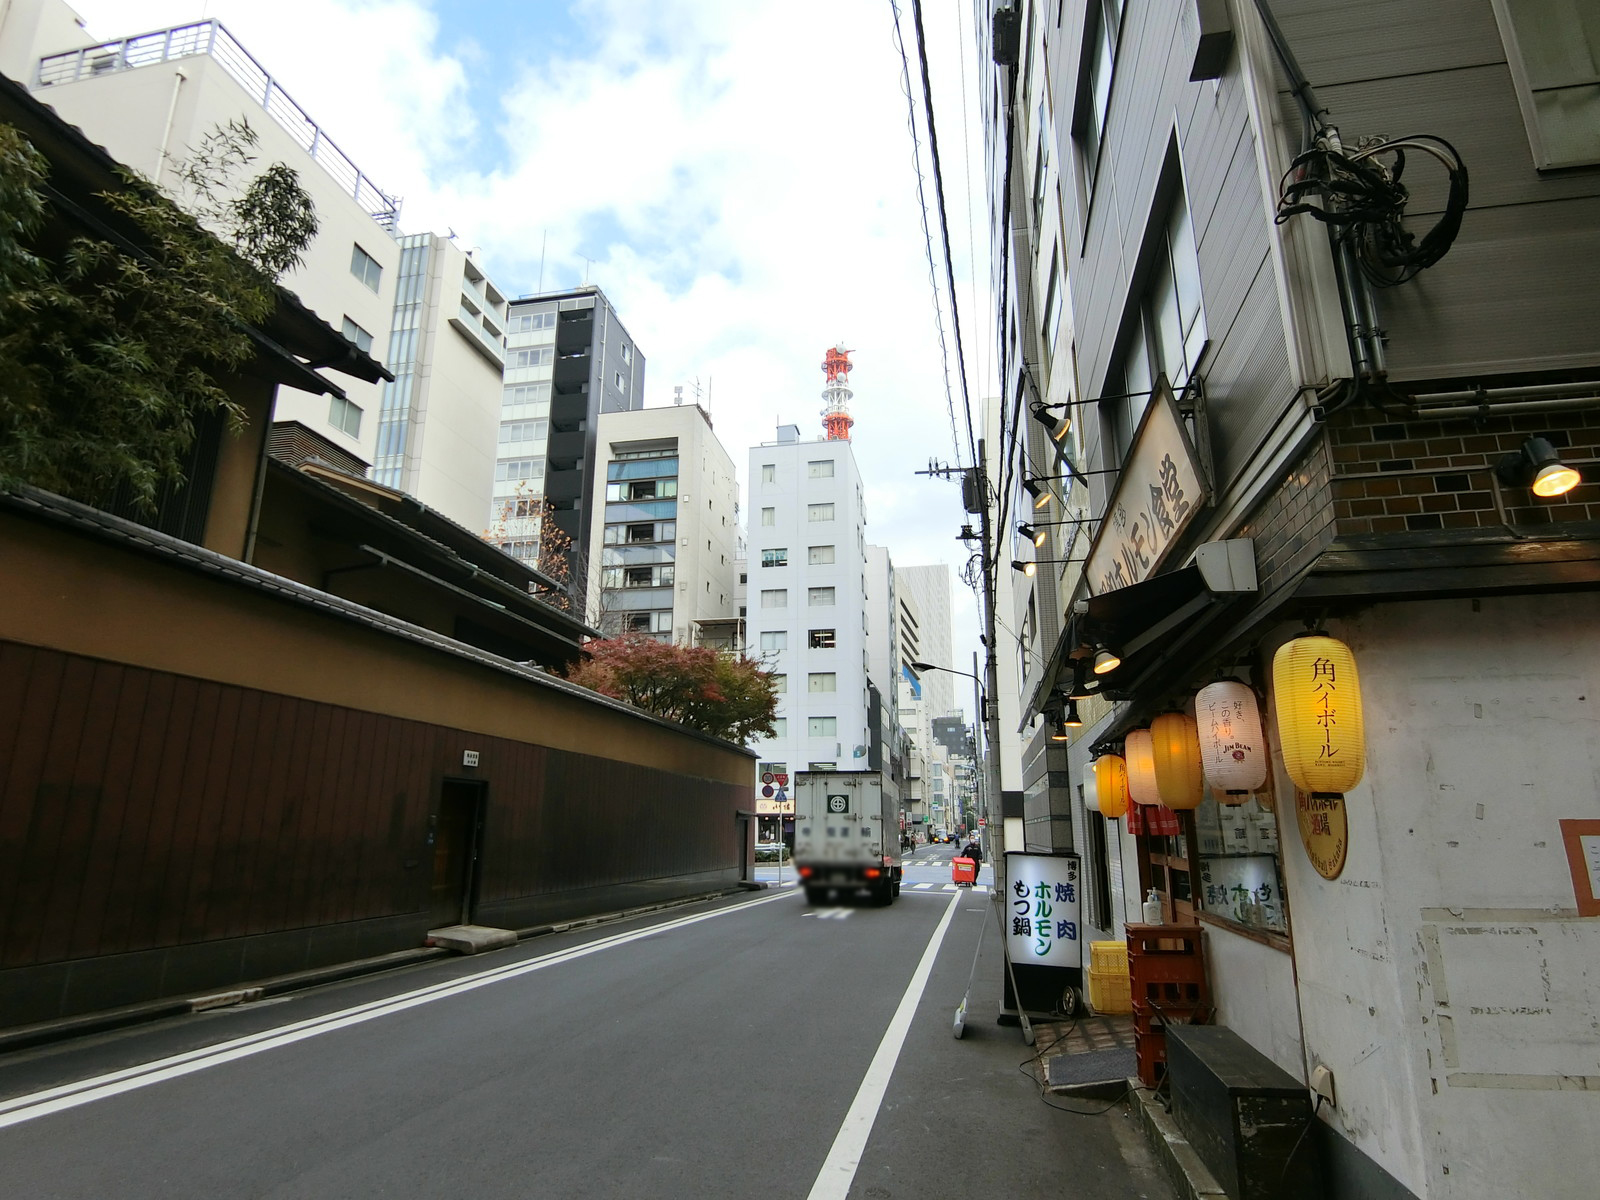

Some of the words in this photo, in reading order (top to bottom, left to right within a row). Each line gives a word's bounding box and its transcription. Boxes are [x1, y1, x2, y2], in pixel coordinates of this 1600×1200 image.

[1311, 657, 1340, 759] 角ハイボール
[1311, 812, 1331, 836] 酒場
[1068, 860, 1077, 881] 博多
[1013, 879, 1031, 937] もつ鍋
[1034, 880, 1053, 956] ホルモン
[1055, 882, 1077, 941] 焼肉
